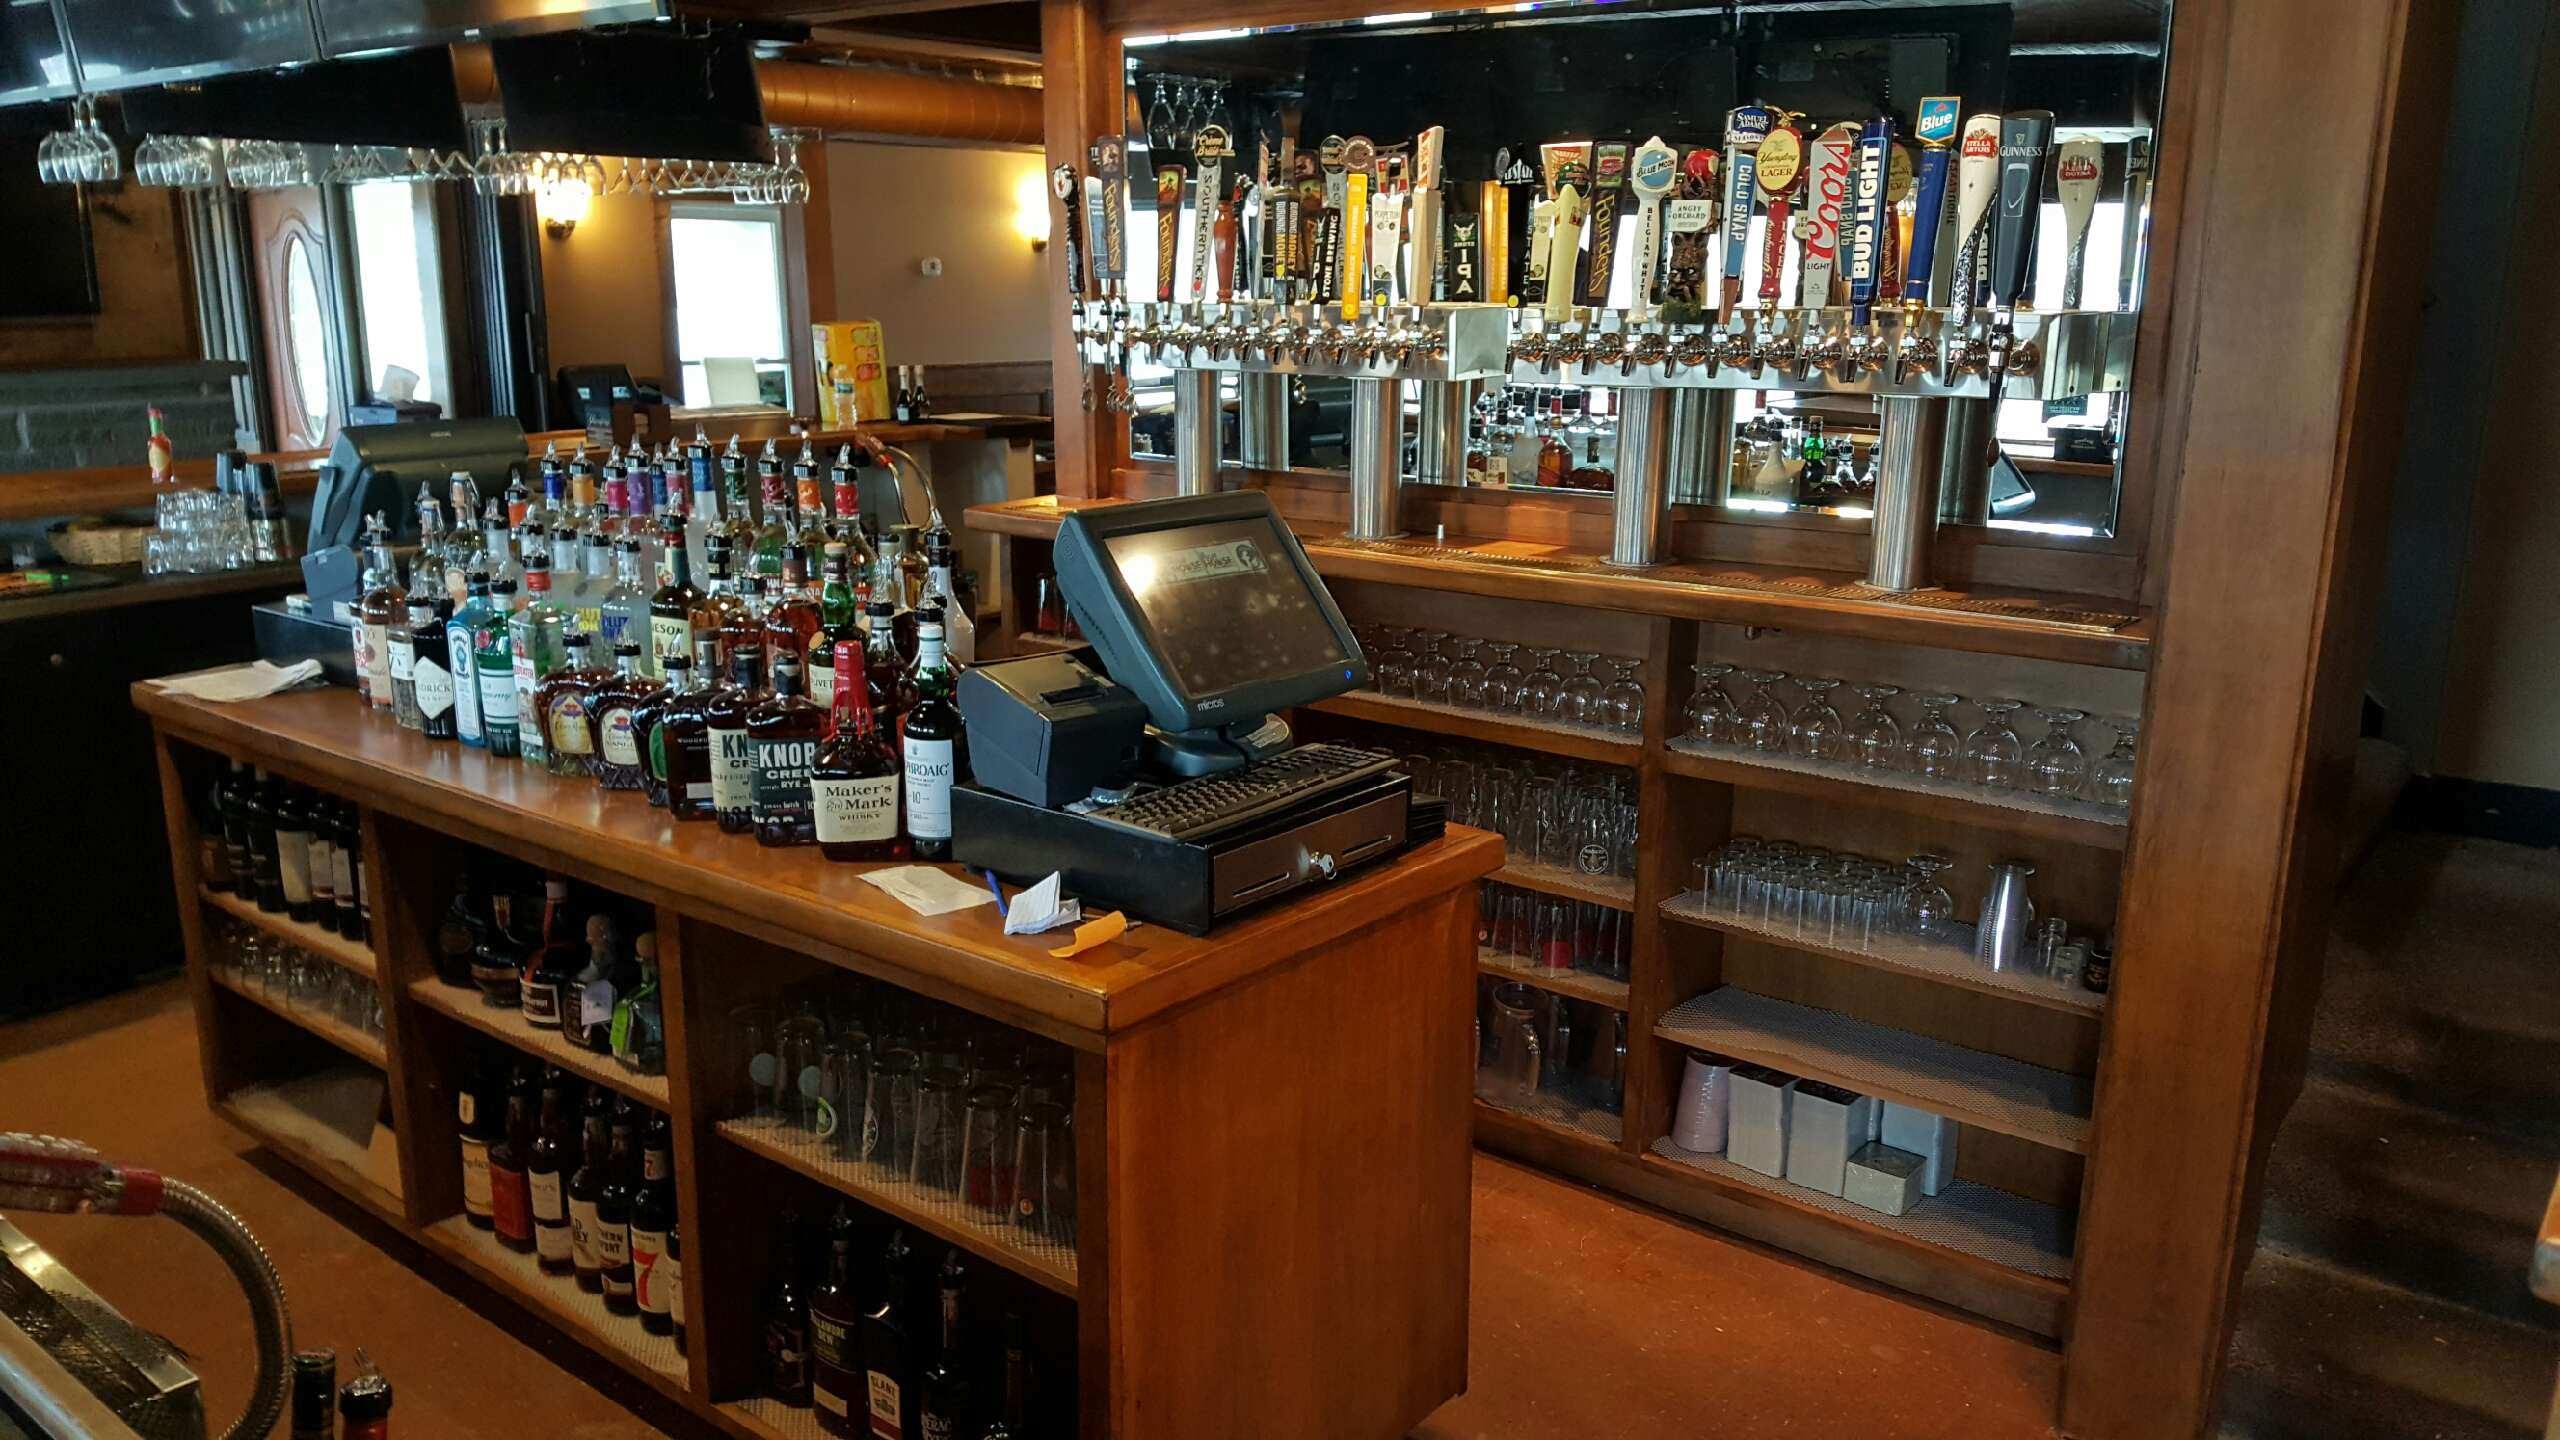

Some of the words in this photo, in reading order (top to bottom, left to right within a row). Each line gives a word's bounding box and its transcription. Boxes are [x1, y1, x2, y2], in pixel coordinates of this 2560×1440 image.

[1737, 112, 1769, 124] SAMUEL
[1738, 119, 1766, 131] ADAMS
[1920, 112, 1953, 132] Blue
[1758, 151, 1799, 164] Yuengling
[1999, 145, 2042, 158] GUINNESS
[1637, 164, 1657, 178] BLUE
[1760, 168, 1793, 177] LAGER
[1736, 165, 1753, 200] COLD
[1857, 145, 1881, 222] LIGHT
[1806, 142, 1851, 260] Coors
[1642, 207, 1653, 258] BELGIAN
[1731, 203, 1750, 241] SNAP
[1159, 212, 1173, 286] Founder
[1275, 233, 1286, 265] MONE
[1326, 215, 1339, 263] BREWING
[1588, 194, 1615, 294] Founders
[1852, 223, 1874, 279] BUD
[1806, 262, 1831, 270] LIGHT
[1322, 265, 1333, 298] STONE
[1639, 264, 1650, 299] WHITE
[1197, 698, 1225, 712] micros
[722, 734, 749, 758] KN
[781, 780, 801, 789] RYE
[825, 784, 893, 797] Maker's
[845, 795, 894, 811] Mark
[912, 792, 922, 804] 10
[839, 811, 881, 822] WHISKY
[633, 1248, 659, 1308] 7
